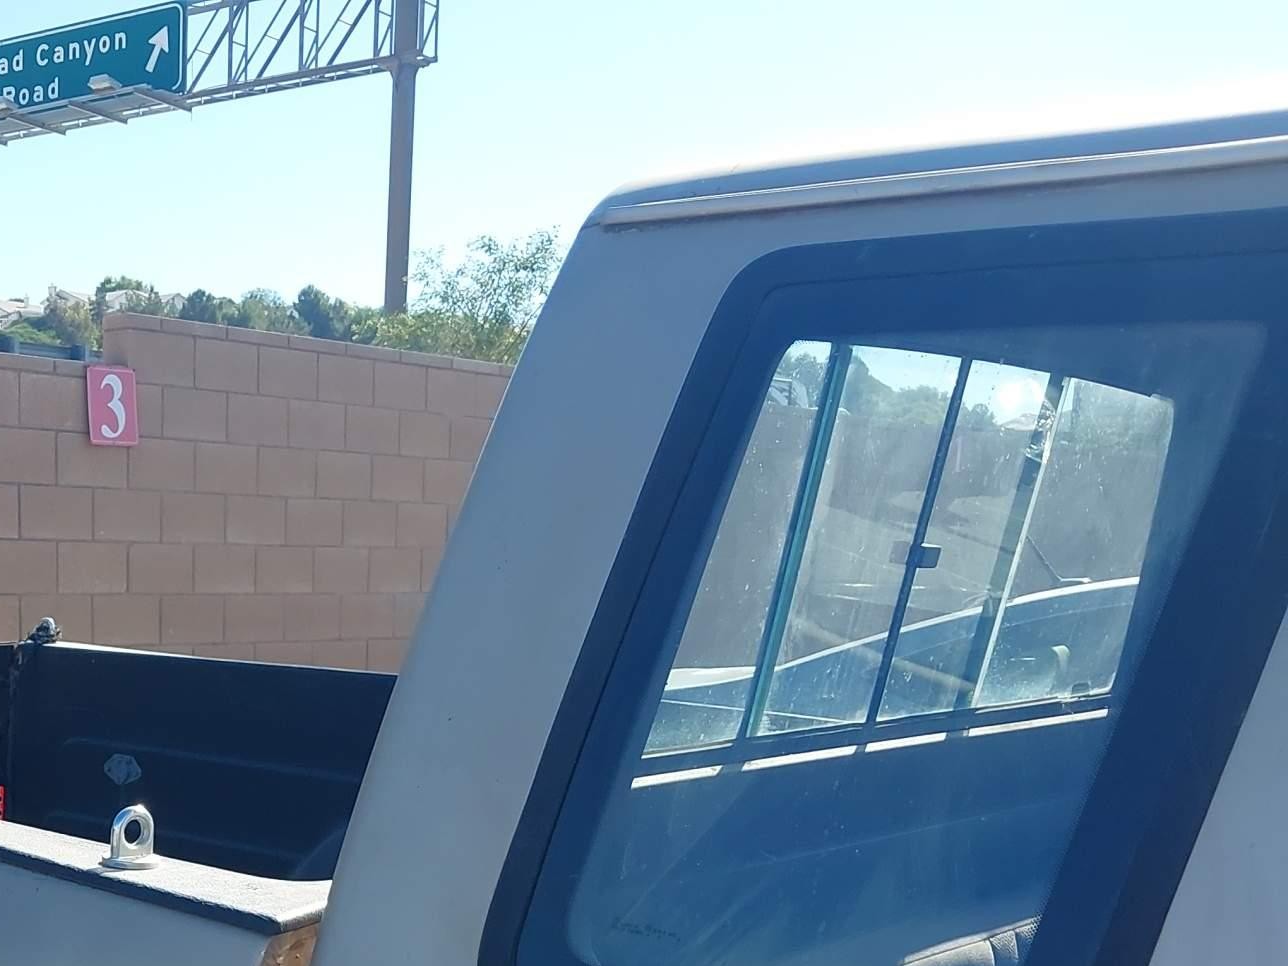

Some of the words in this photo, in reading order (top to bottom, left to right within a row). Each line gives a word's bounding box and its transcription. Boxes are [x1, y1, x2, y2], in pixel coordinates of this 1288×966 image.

[36, 31, 127, 66] Canyon
[2, 77, 60, 106] Road
[100, 373, 126, 439] 3
